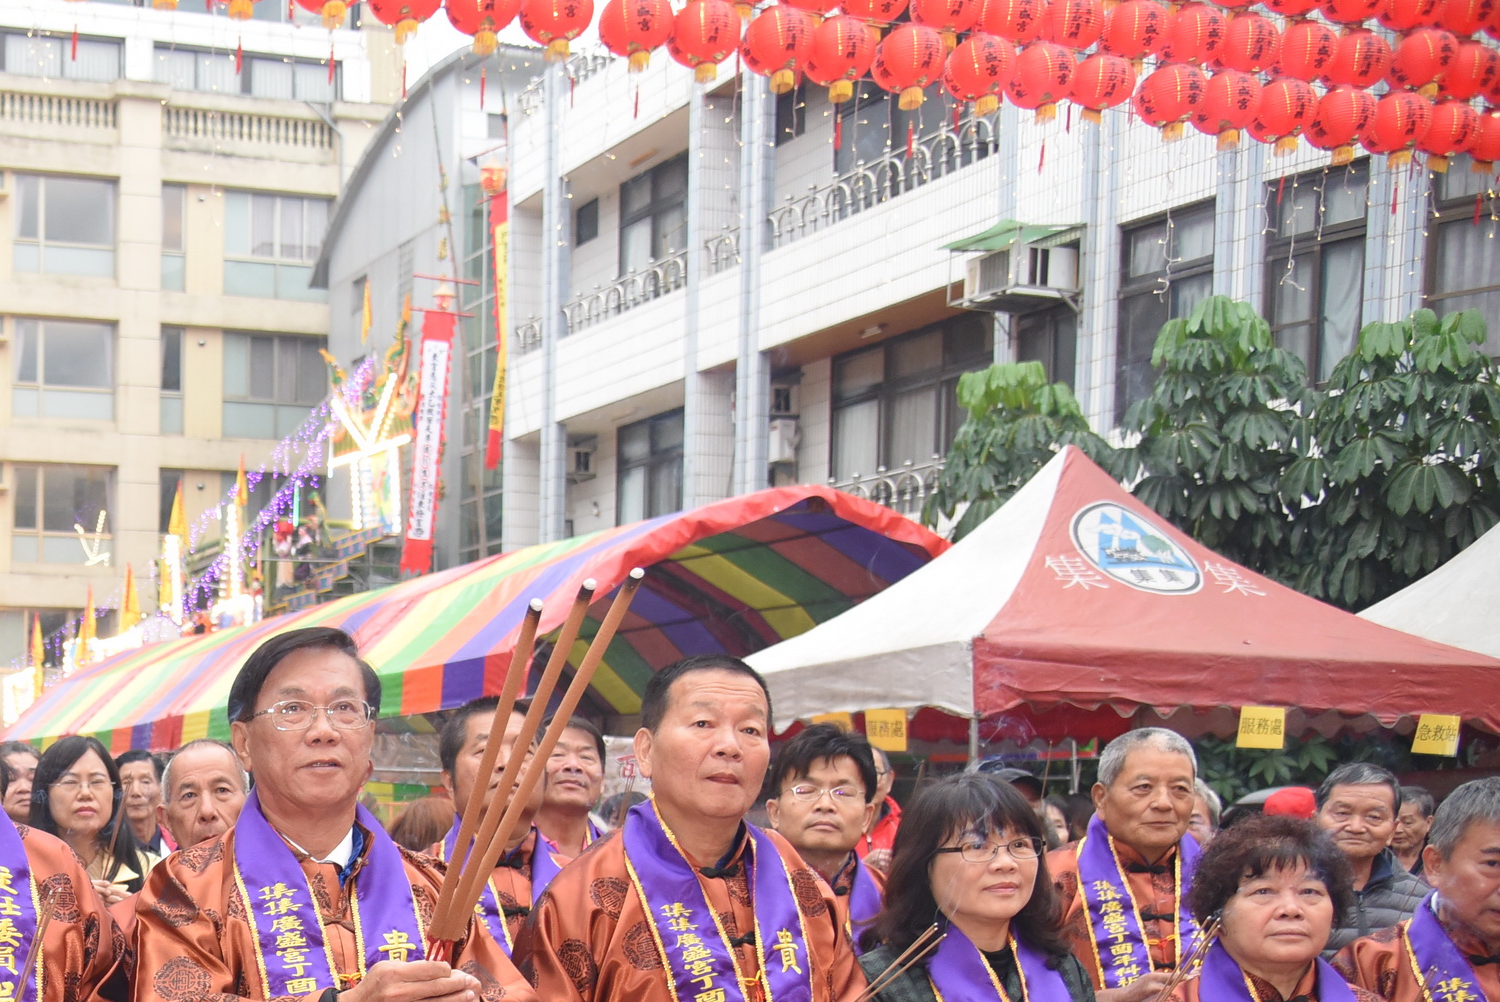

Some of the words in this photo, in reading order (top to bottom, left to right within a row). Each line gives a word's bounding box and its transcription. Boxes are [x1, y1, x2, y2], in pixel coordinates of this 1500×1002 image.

[1045, 555, 1109, 590] 集
[1203, 561, 1267, 596] 集
[1240, 717, 1283, 736] 服務處
[1417, 724, 1458, 742] 急救站
